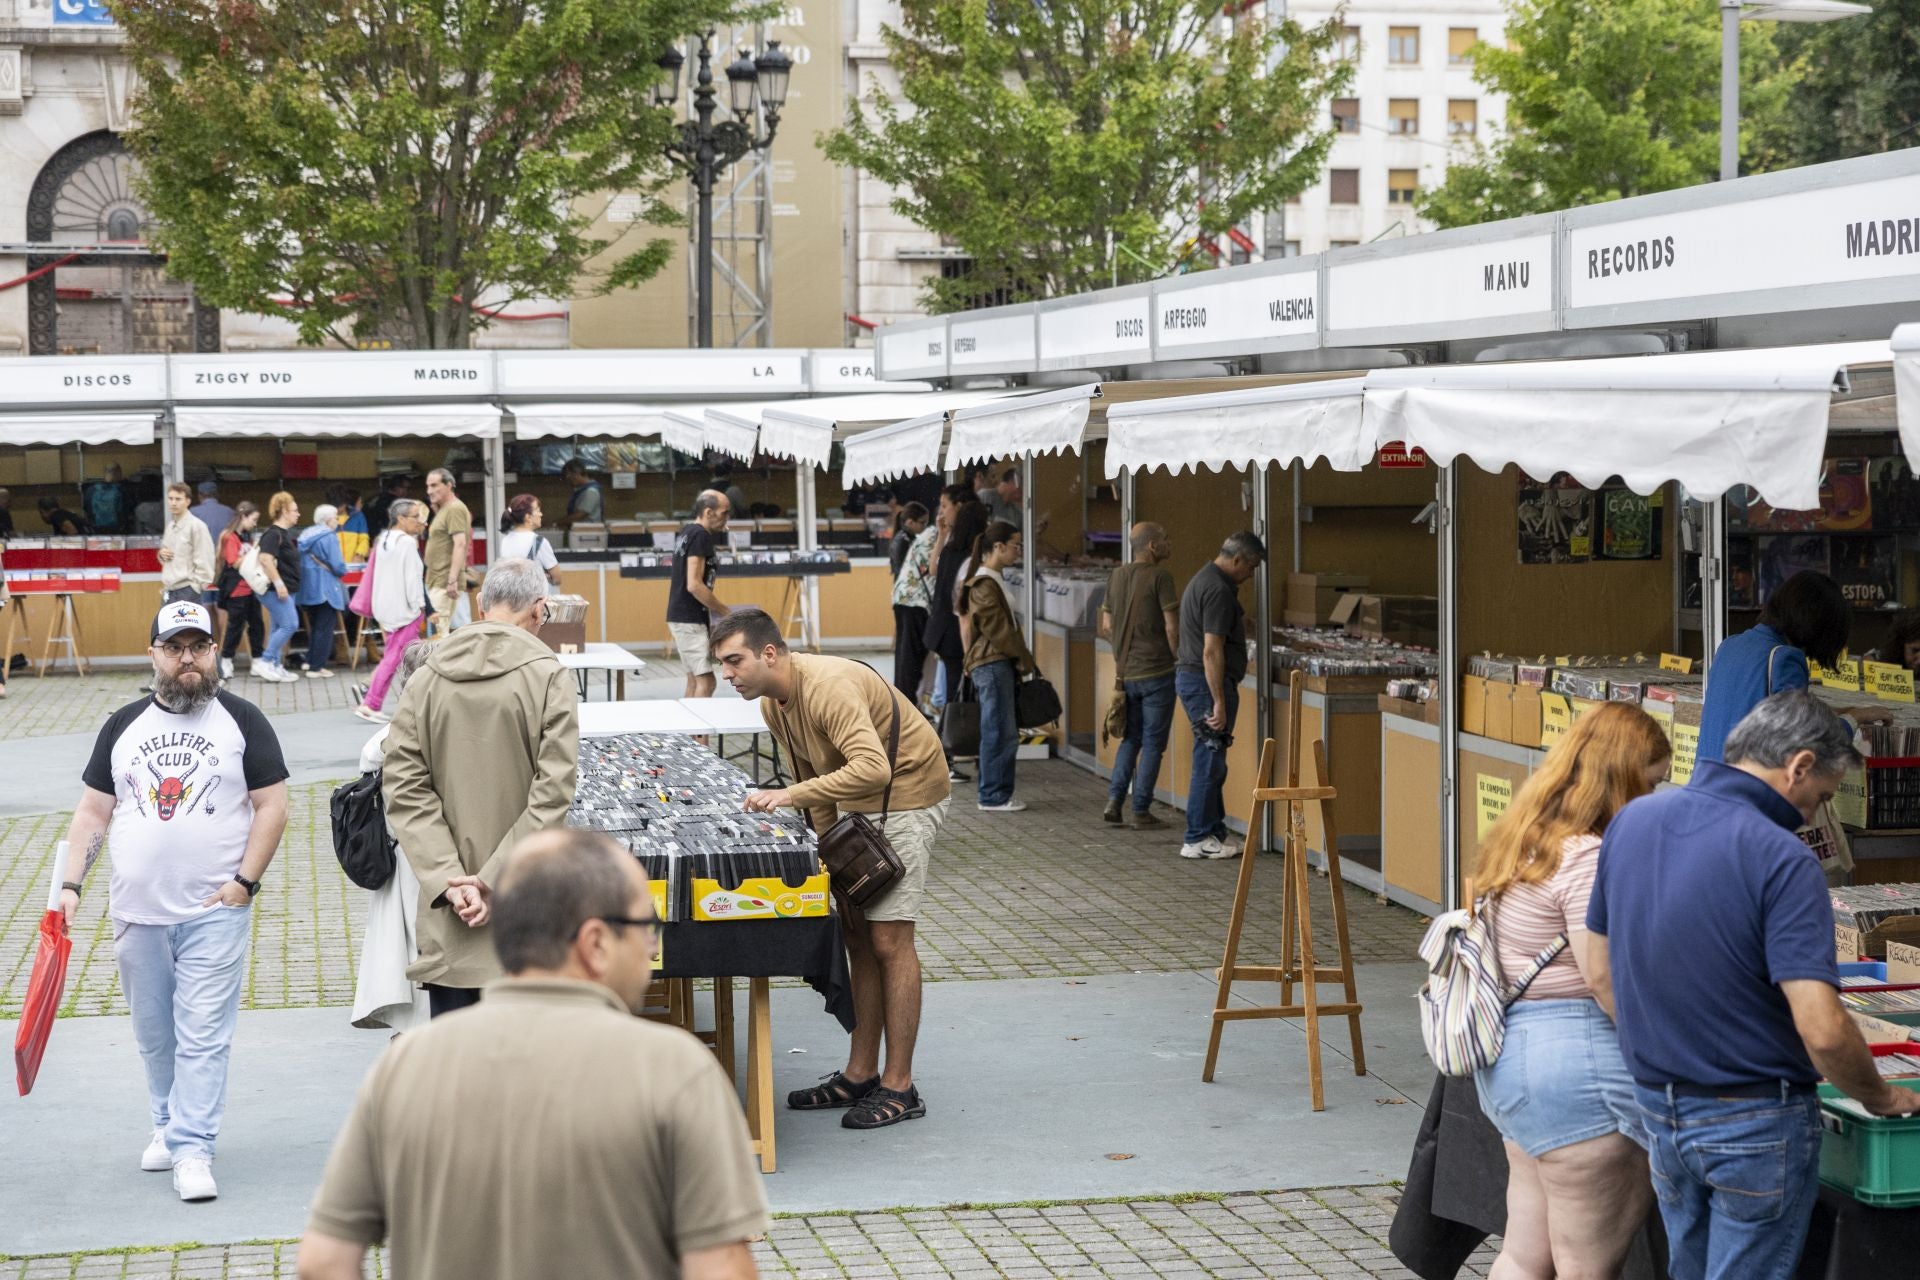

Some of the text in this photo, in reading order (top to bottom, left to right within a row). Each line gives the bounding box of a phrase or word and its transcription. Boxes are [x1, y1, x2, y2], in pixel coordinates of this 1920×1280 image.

[1588, 235, 1675, 279] RECORDS
[1484, 261, 1530, 291] MANU
[1164, 297, 1314, 329] ARPEGGIO VALENCIA
[1116, 318, 1144, 338] DISCOS
[195, 369, 478, 384] ZIGGY DVD MADRID
[753, 366, 775, 377] LA
[64, 374, 132, 386] DISCOS
[1609, 498, 1648, 512] CAN
[1841, 584, 1886, 600] ESTOPA
[157, 752, 192, 766] CLUB
[708, 902, 732, 913] Zespri
